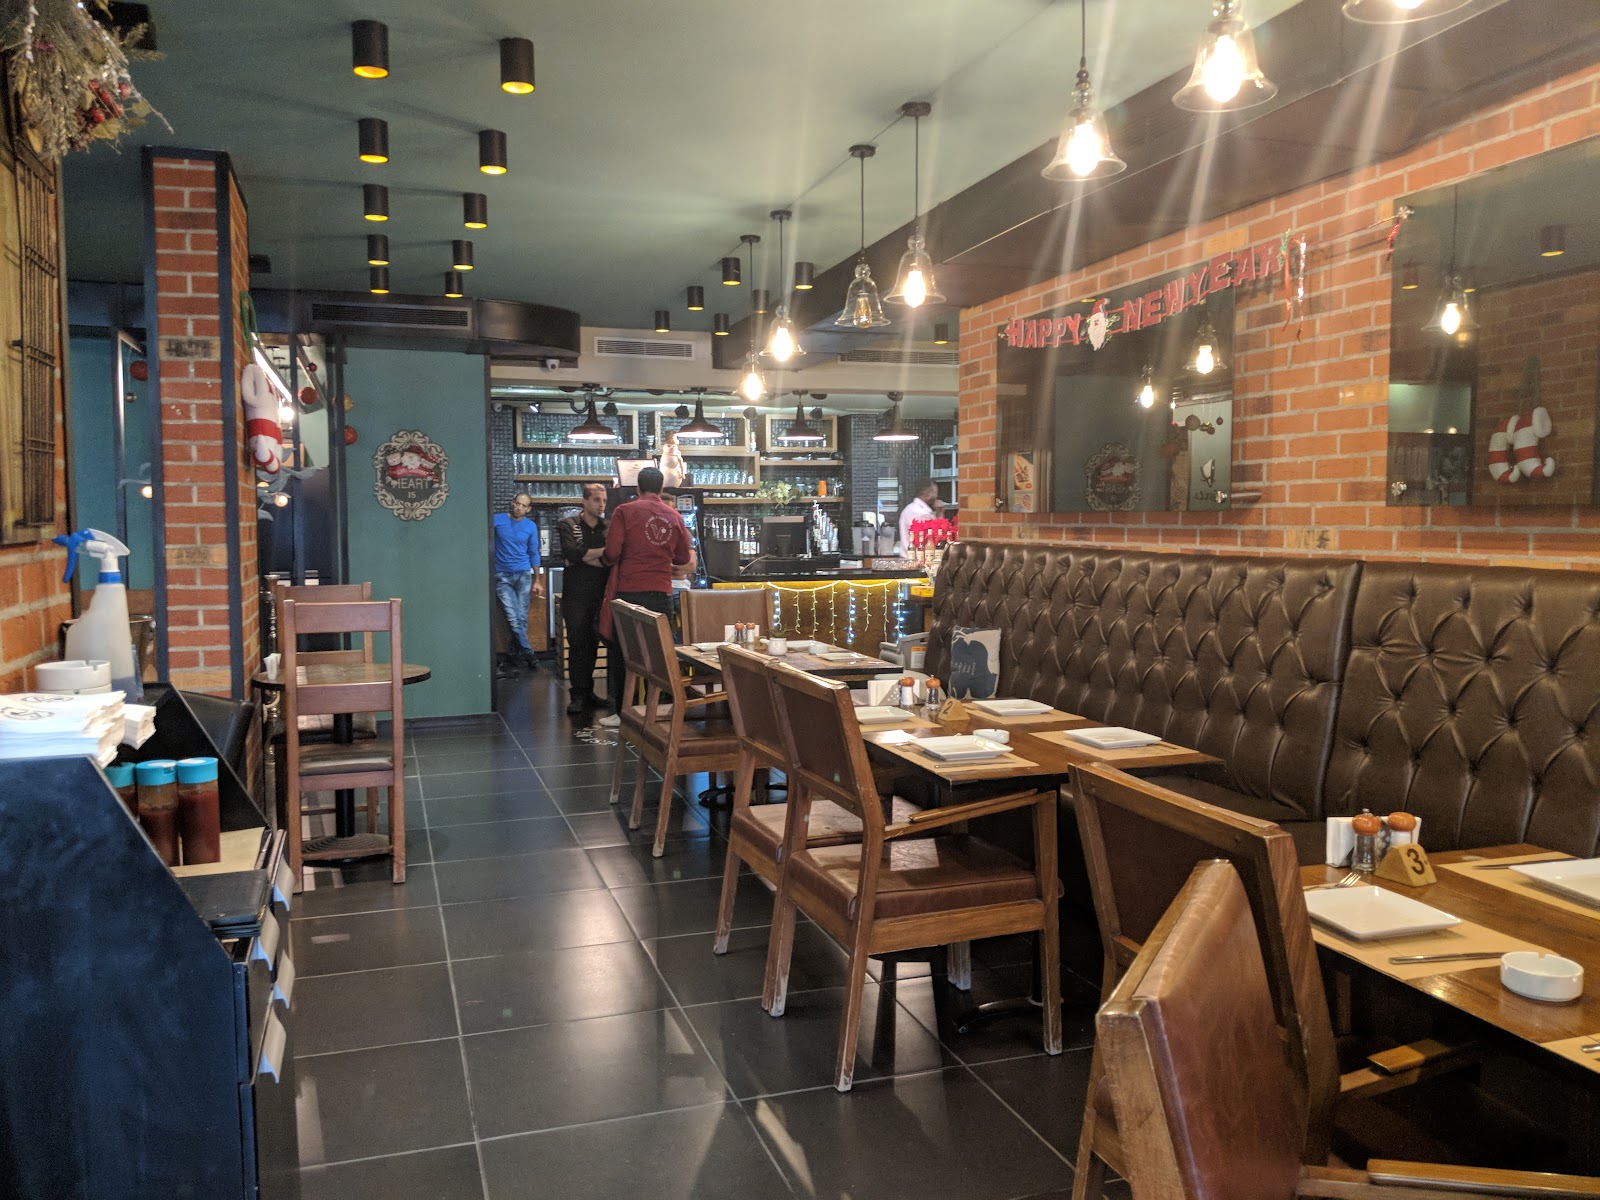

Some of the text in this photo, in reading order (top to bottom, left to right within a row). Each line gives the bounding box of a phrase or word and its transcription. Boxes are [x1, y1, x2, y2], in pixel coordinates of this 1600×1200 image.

[1006, 313, 1081, 348] HAPPY
[942, 700, 953, 715] 2
[1406, 848, 1425, 875] 3
